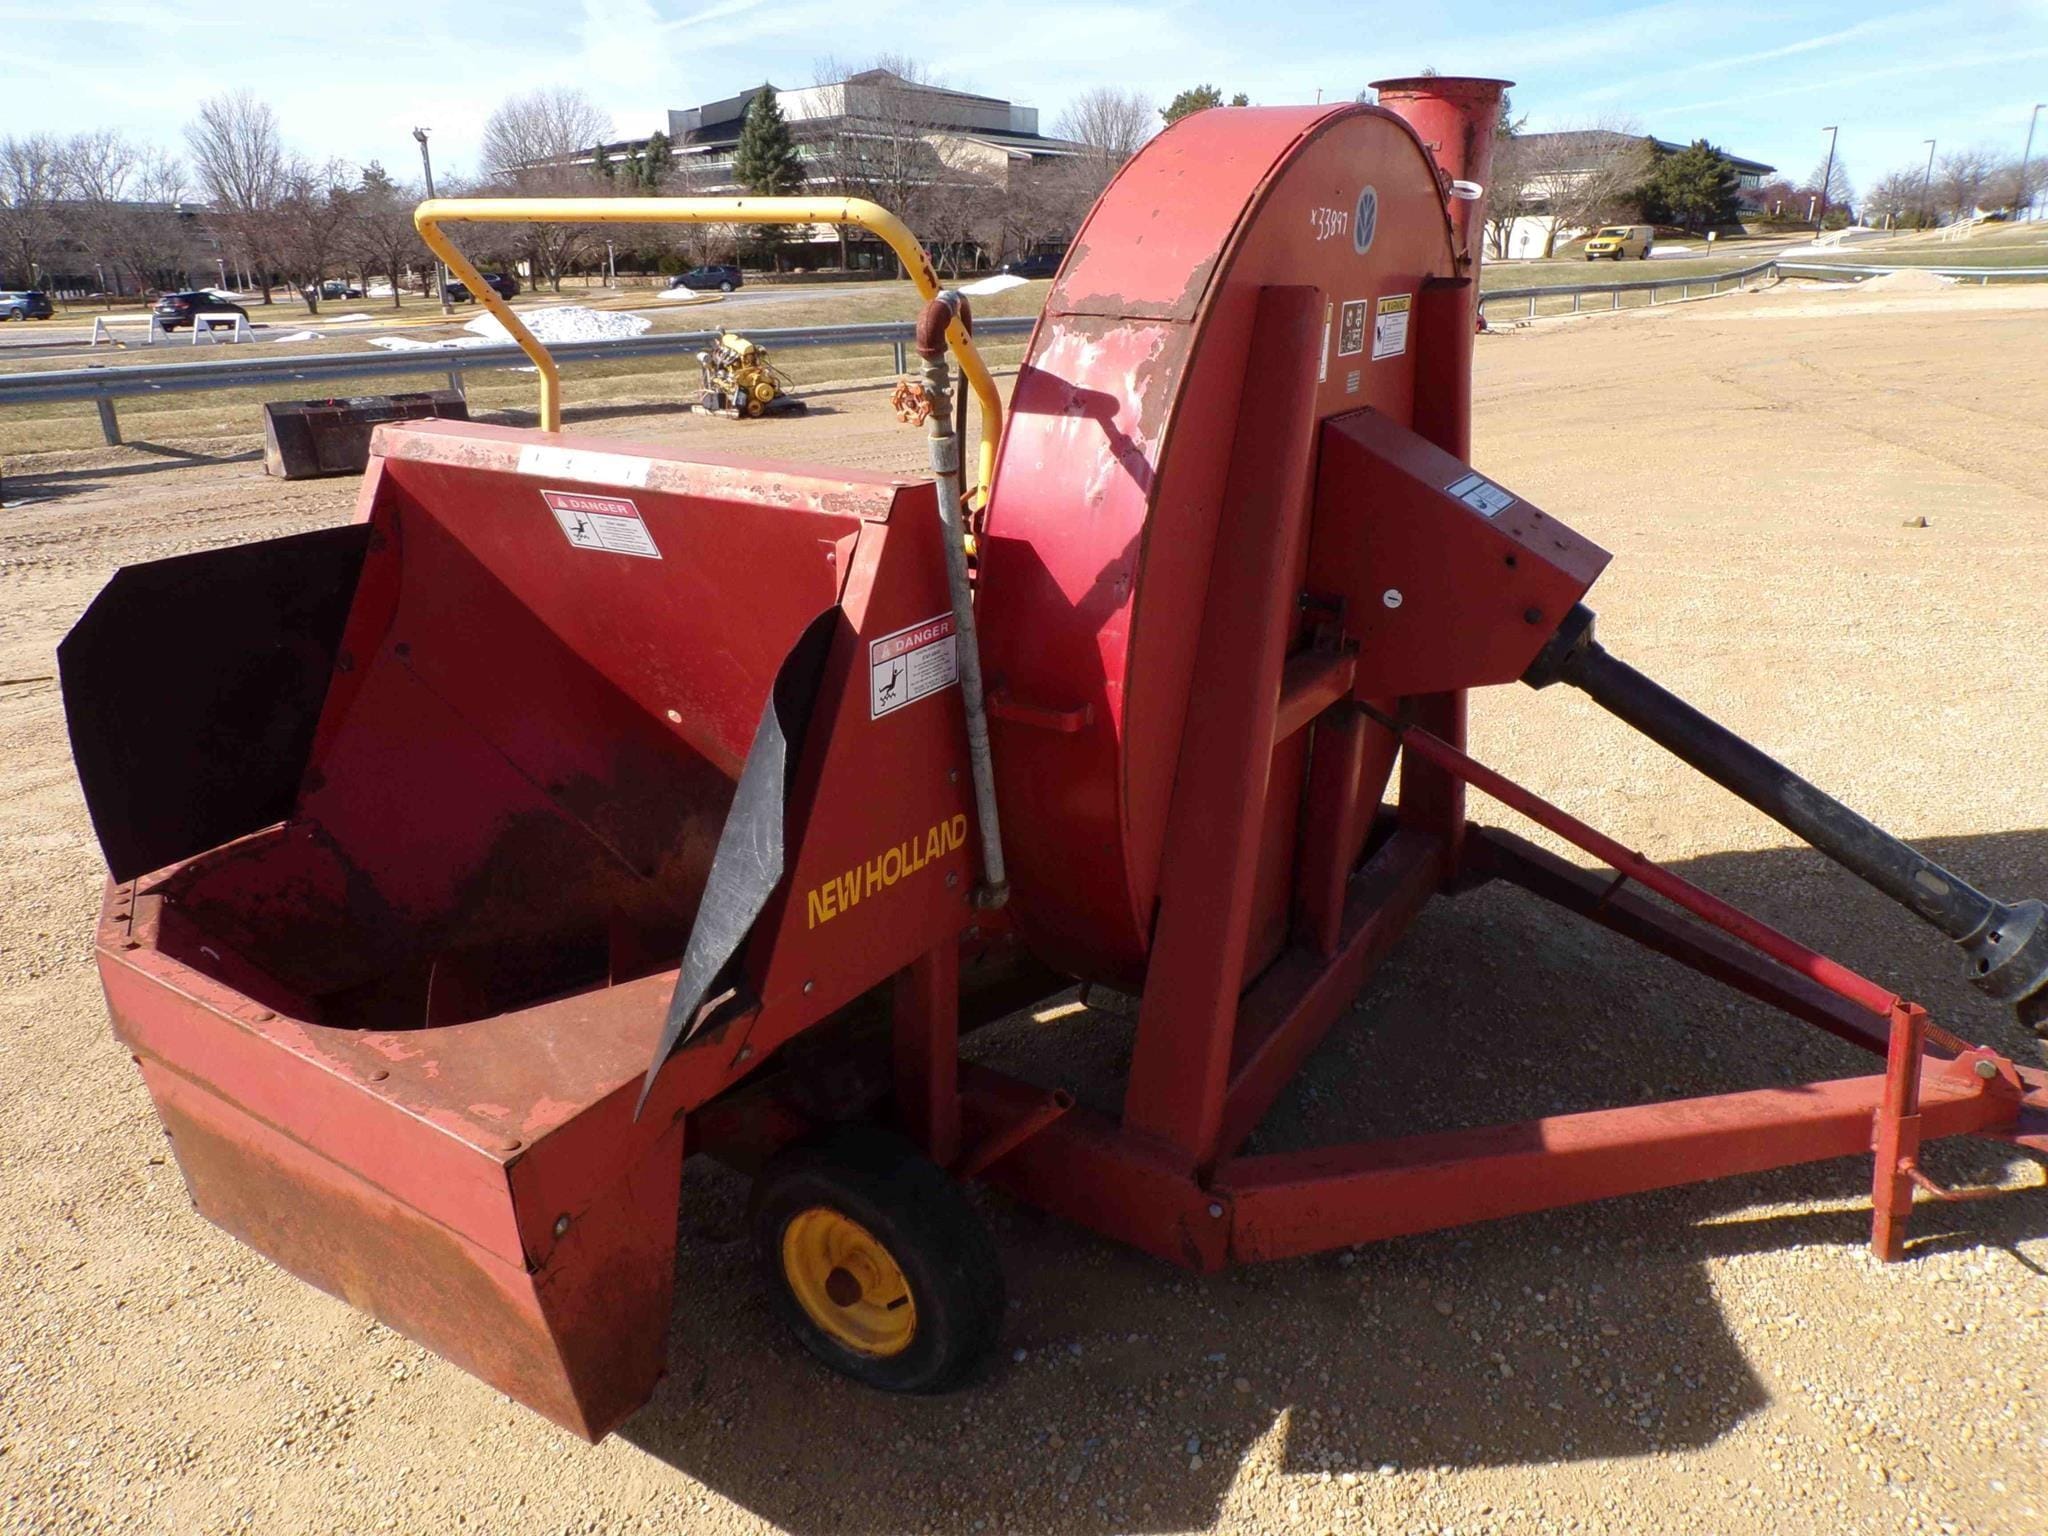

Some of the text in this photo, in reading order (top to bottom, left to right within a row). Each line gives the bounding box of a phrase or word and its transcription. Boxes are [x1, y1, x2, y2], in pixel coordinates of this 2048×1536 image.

[568, 499, 629, 515] DANGER
[895, 622, 949, 651] DANGER
[808, 813, 967, 930] NEW HOLLAND
